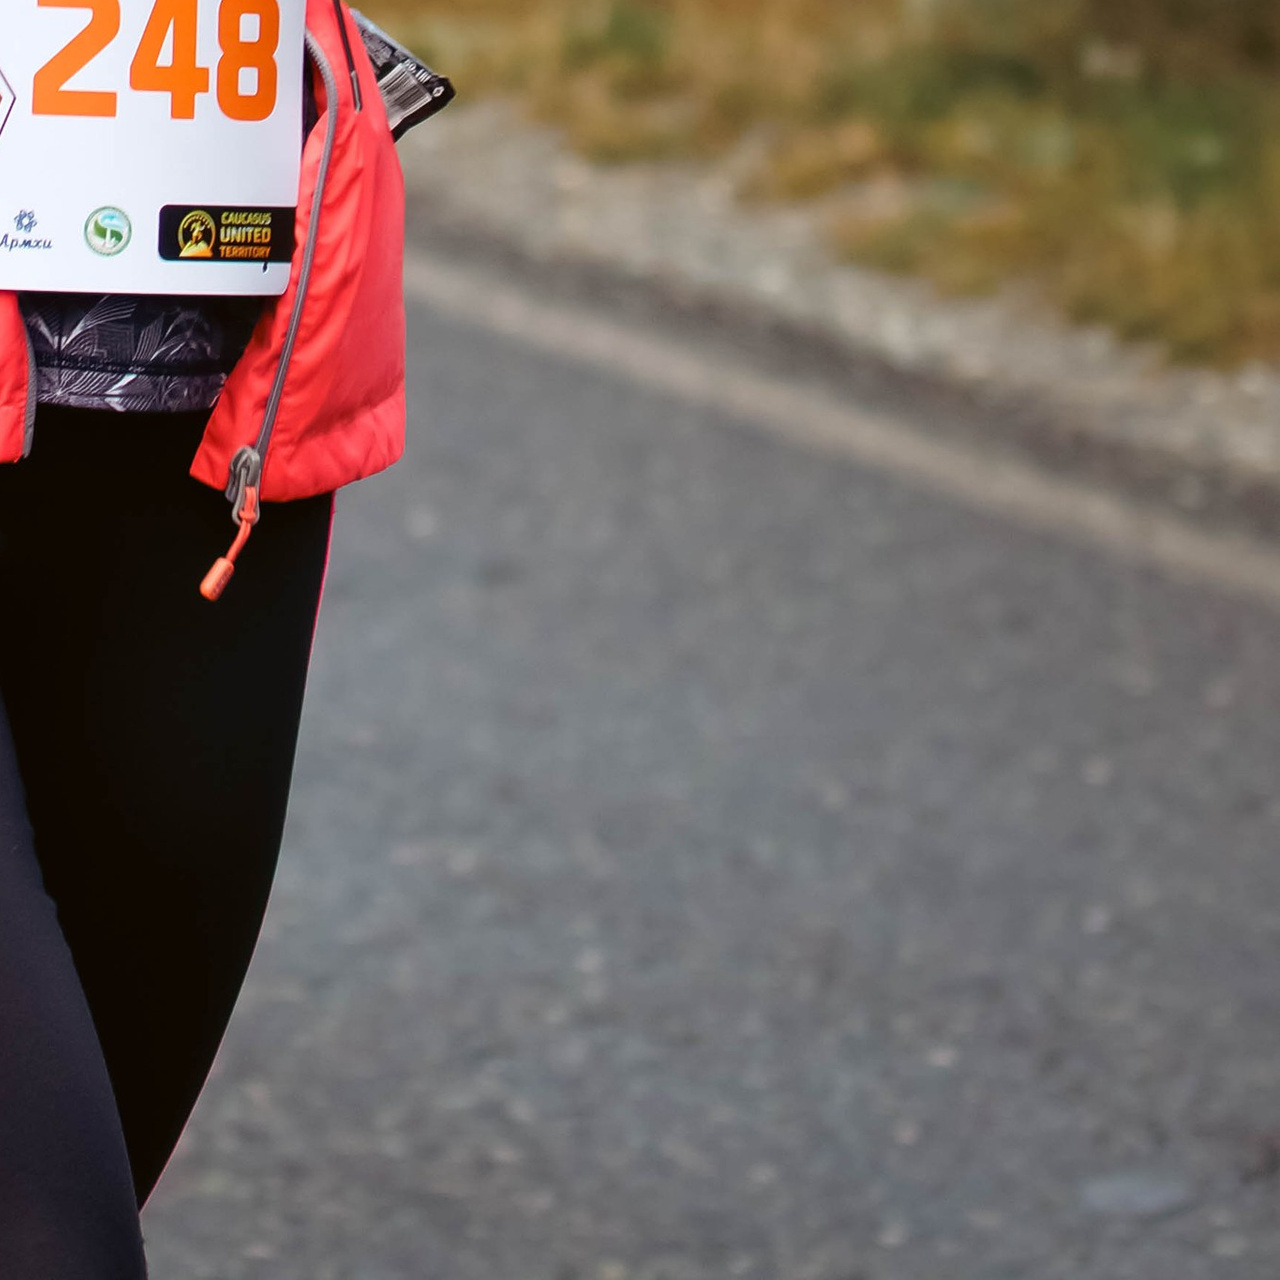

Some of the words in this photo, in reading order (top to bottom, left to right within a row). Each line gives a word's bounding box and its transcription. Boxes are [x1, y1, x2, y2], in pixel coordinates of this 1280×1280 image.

[220, 211, 273, 226] CAUCASUS
[219, 226, 272, 244] UNITED
[219, 245, 272, 259] TERRITORY
